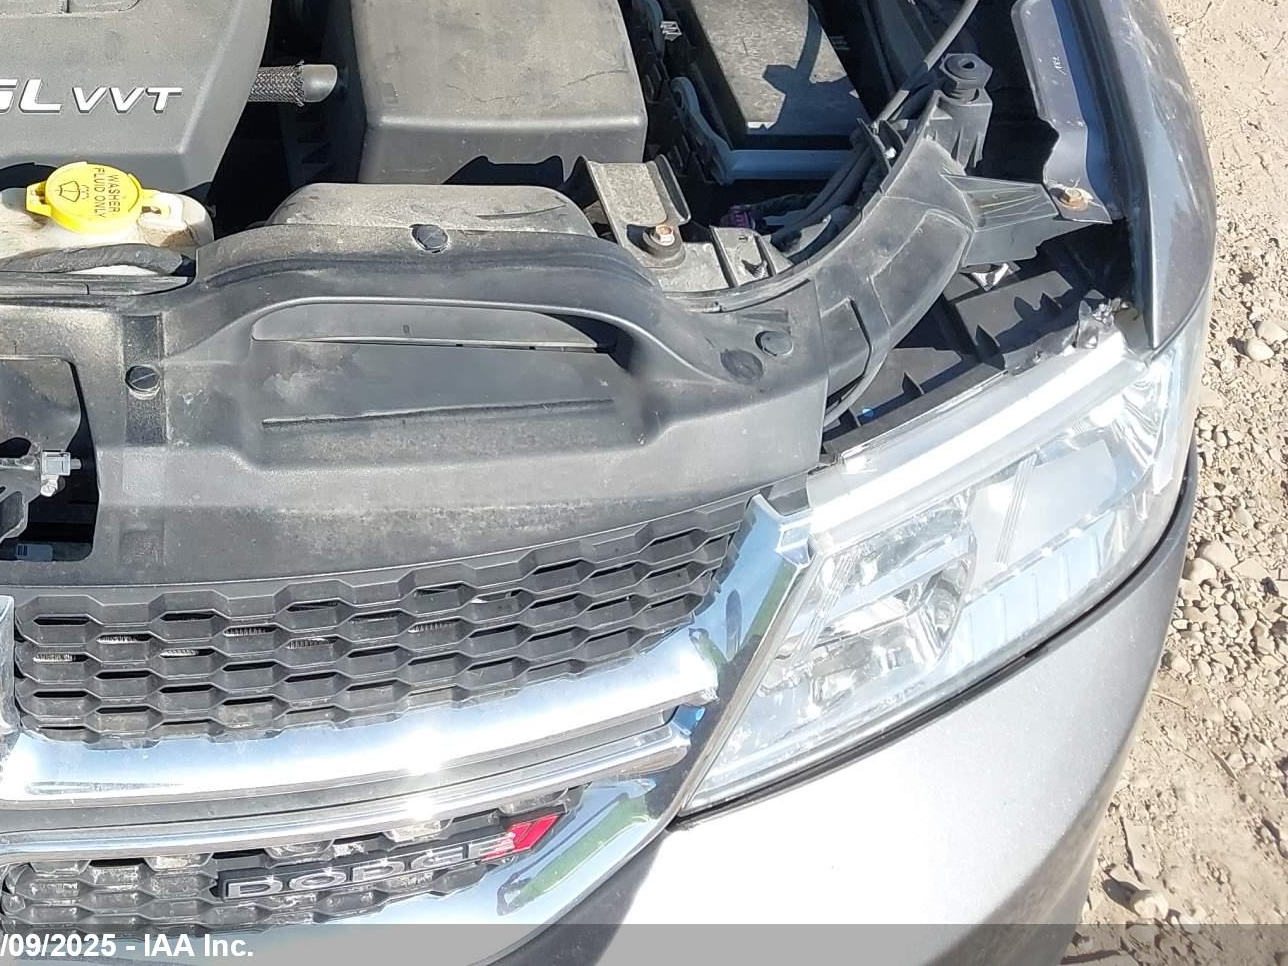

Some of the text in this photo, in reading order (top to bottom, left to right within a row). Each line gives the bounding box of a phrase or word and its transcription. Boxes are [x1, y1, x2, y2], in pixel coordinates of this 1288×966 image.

[71, 86, 184, 115] VVT
[93, 167, 107, 219] FLUID ONLY
[107, 174, 121, 213] WASHER
[225, 832, 516, 901] DODGE
